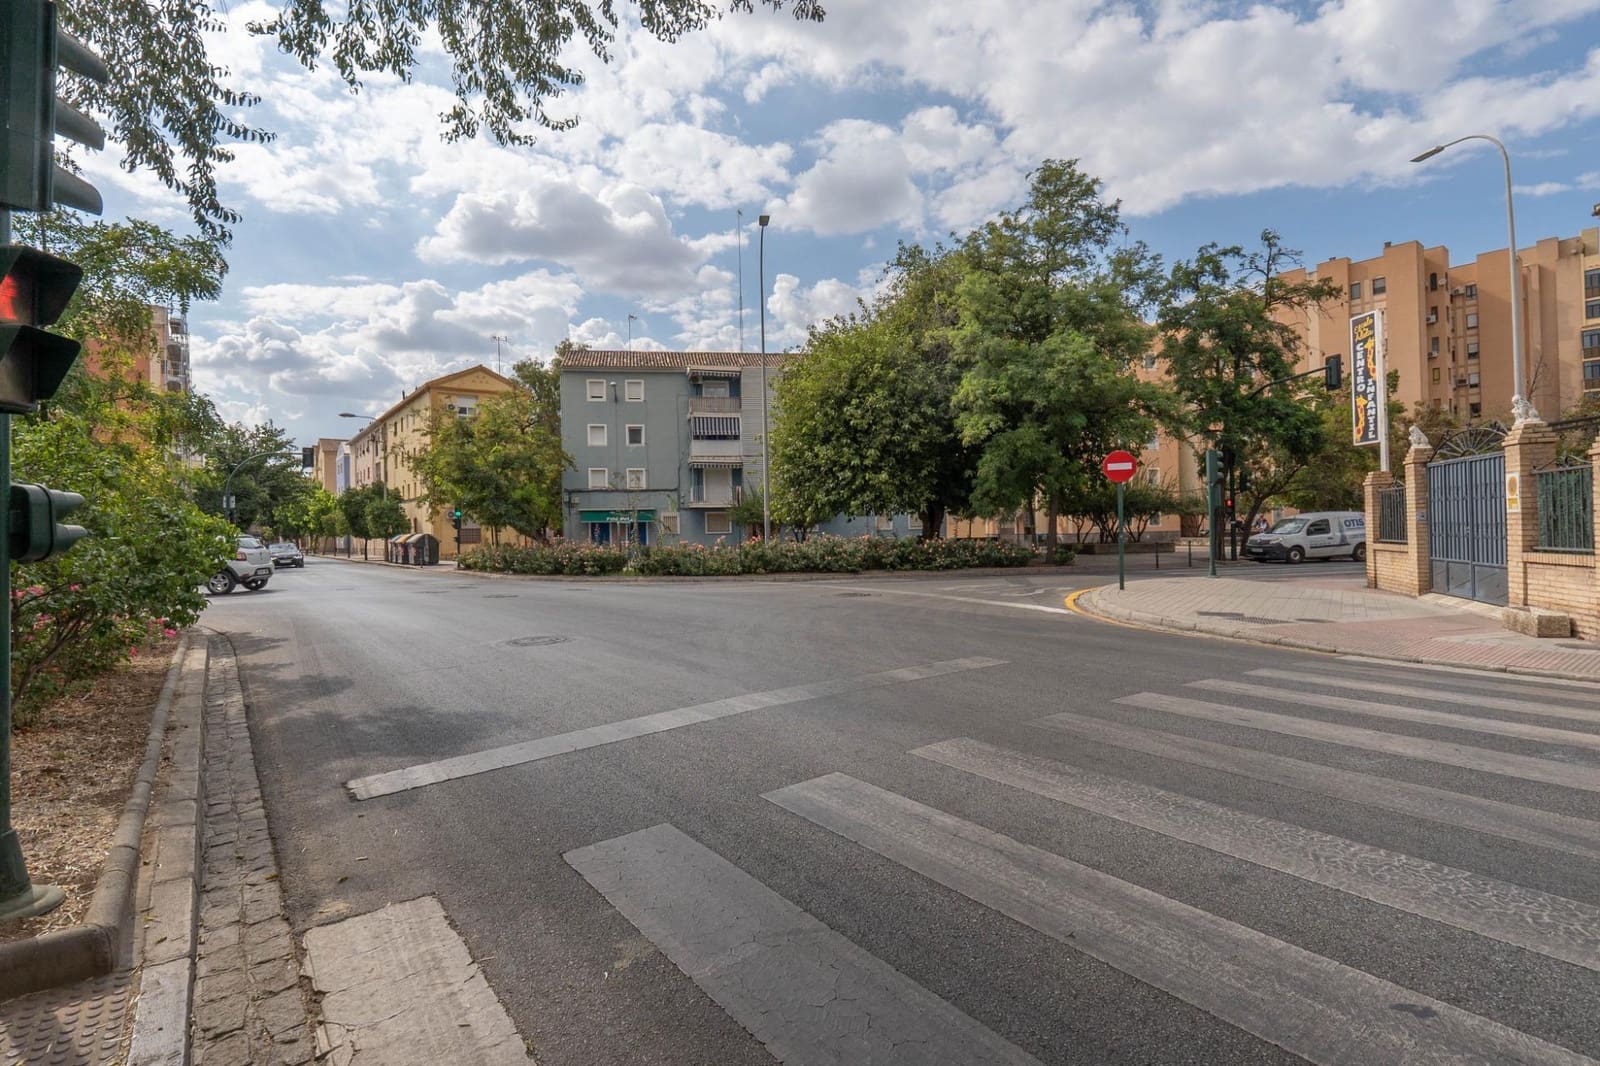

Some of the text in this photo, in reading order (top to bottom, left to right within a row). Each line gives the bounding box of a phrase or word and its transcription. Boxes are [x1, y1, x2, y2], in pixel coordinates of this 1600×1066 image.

[1356, 342, 1366, 392] CENTRO
[1366, 378, 1376, 439] INFANTIL
[1344, 518, 1364, 527] OTIS
